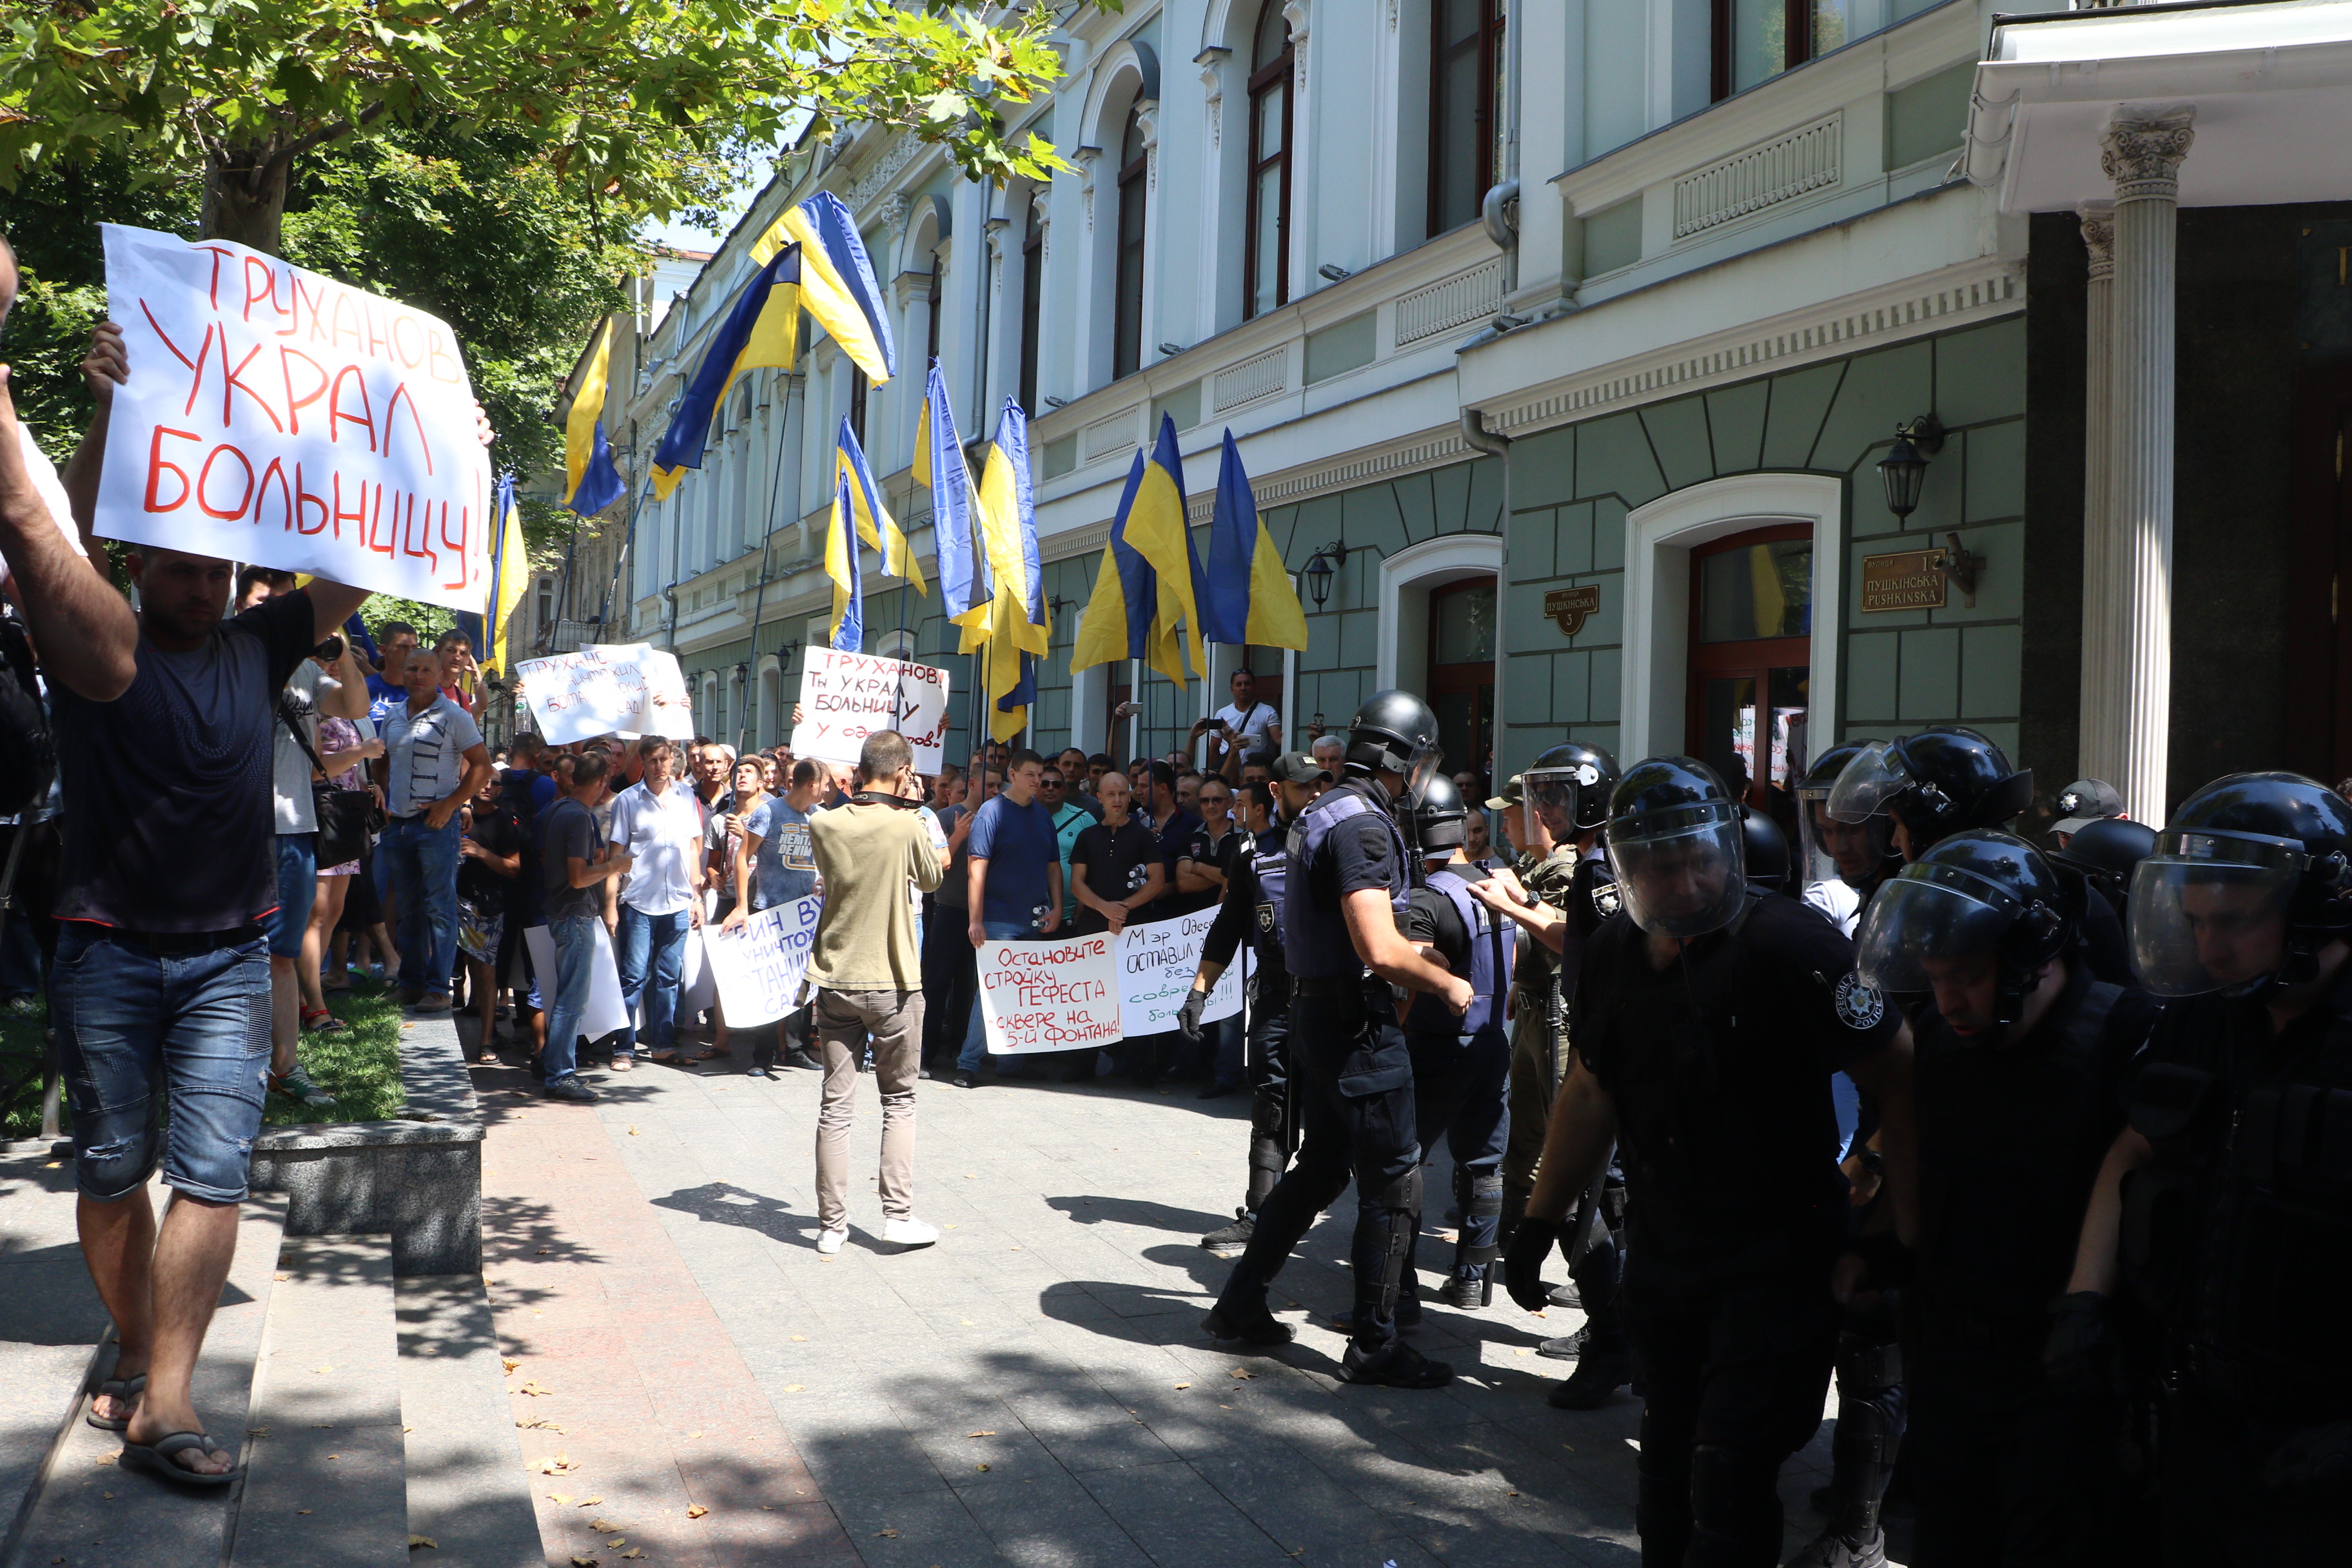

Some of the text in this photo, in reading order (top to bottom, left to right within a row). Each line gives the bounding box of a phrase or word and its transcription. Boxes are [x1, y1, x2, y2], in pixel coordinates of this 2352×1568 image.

[187, 246, 460, 384] ТРУХАНОВ
[139, 297, 433, 476] УКРАЛ
[143, 424, 480, 591] БОЛЬНИЦУ!
[1868, 559, 1894, 569] ВУЛИЦЯ
[1867, 574, 1939, 593] ПУШКІНСЬКА
[1547, 597, 1595, 612] ПУШКІНСЬКА
[1868, 590, 1937, 606] PUSHKINSKA
[1566, 613, 1573, 626] 3
[823, 653, 945, 689] ТРУХАНОВ!
[841, 675, 905, 698] УКРАЛ
[1126, 927, 1171, 949] Мэр
[1019, 979, 1106, 1007] ГЕФЕСТА
[1044, 1003, 1121, 1046] ФОНТАНА!
[1855, 999, 1883, 1028] POLICE
